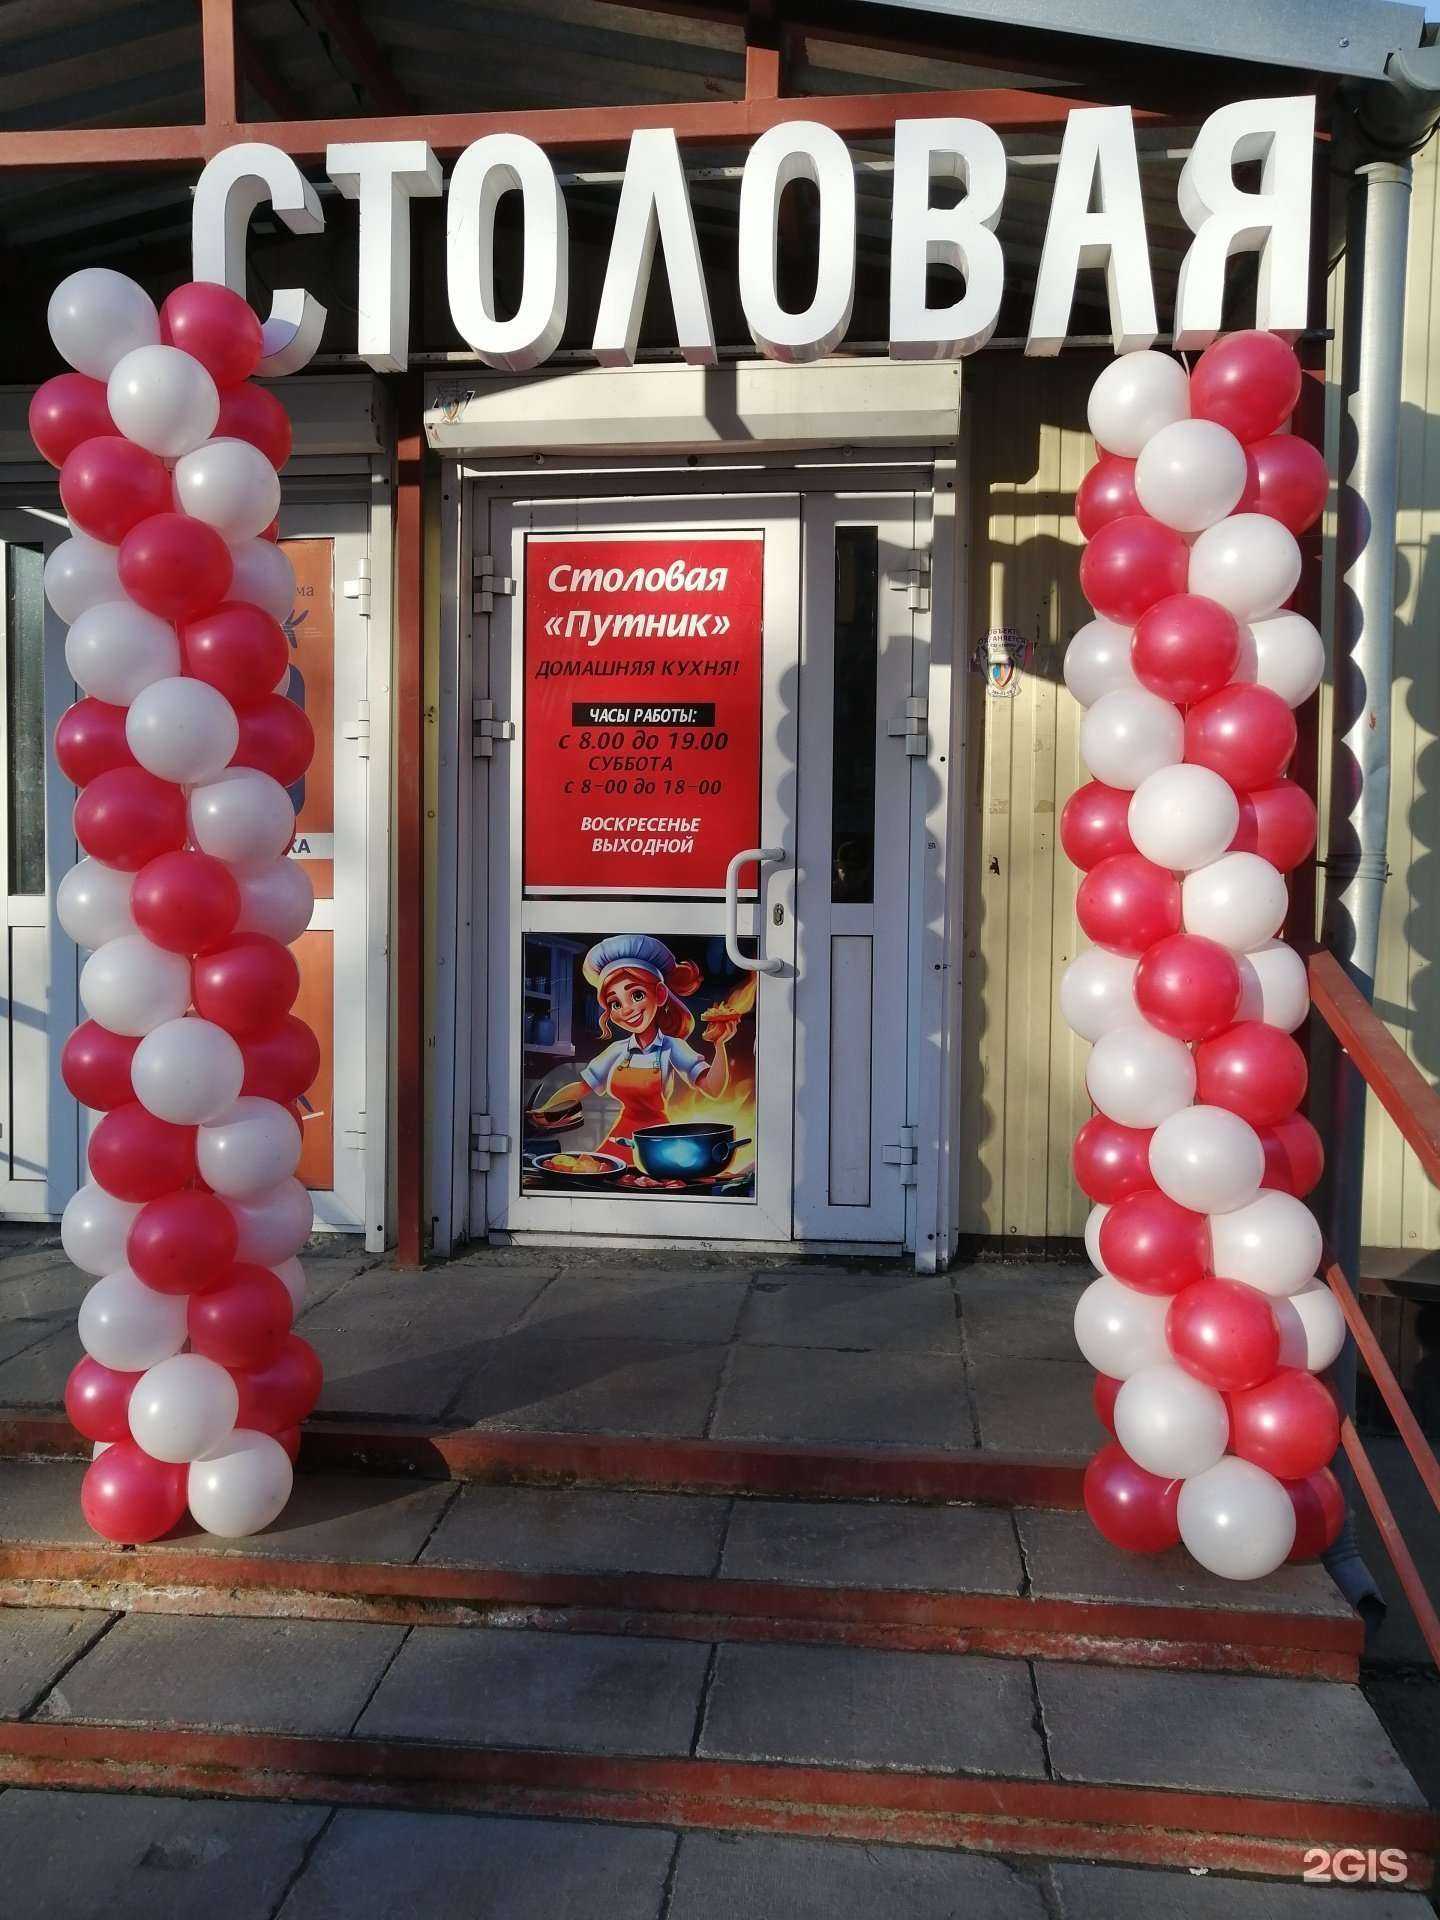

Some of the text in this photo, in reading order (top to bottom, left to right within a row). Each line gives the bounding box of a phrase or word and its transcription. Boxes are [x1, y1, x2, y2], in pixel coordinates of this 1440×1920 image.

[192, 94, 1317, 375] СТОЛОВАЯ
[548, 559, 729, 593] Столовая
[544, 610, 731, 647] «Путник»
[534, 660, 740, 679] ДОМАШНЯЯ КУХНЯ!
[589, 708, 698, 723] ЧАСЫ РАБОТЫ:
[578, 731, 625, 750] 8.00
[631, 730, 659, 750] до
[668, 732, 729, 750] 19.00
[588, 756, 673, 771] СУББОТА
[633, 778, 656, 795] до
[580, 816, 702, 833] ВОСКРЕСЕНЬЕ
[591, 836, 694, 856] ВЫХОДНОЙ
